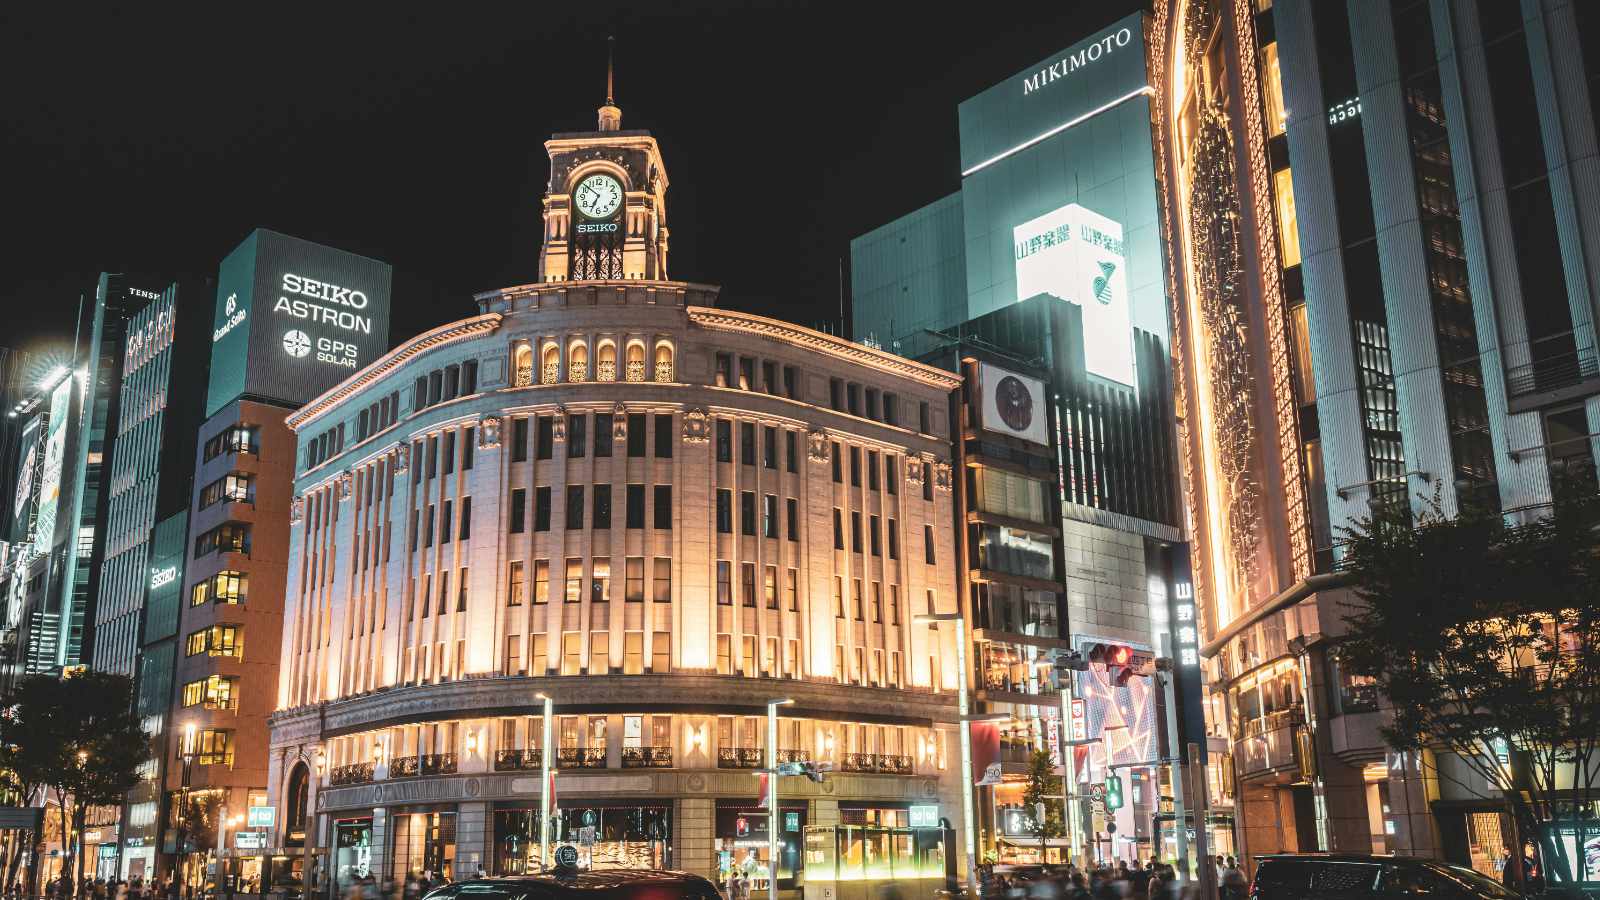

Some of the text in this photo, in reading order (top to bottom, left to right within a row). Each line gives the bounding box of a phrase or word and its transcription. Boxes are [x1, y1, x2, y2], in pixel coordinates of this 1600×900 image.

[1024, 28, 1131, 95] MIKIMOTO
[579, 193, 586, 201] 9
[608, 199, 615, 207] 4
[582, 200, 588, 208] 8
[595, 207, 601, 215] 6
[577, 223, 618, 233] SEIKO
[282, 273, 368, 309] SEIKO
[273, 296, 371, 334] ASTRON
[317, 337, 358, 358] GPS
[316, 352, 357, 368] SOLAR
